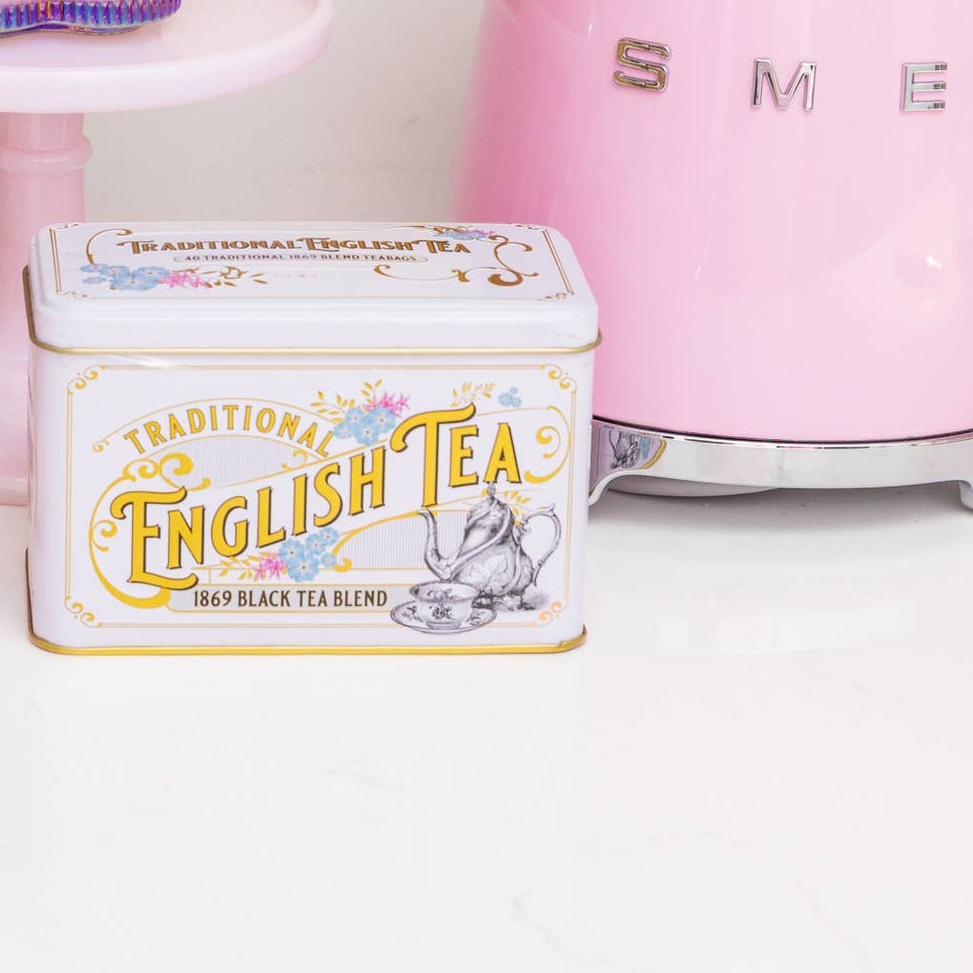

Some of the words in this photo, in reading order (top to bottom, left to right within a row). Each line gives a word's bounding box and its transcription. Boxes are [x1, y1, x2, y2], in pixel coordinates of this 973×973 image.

[116, 240, 302, 255] TRADITIONAL
[297, 237, 414, 253] ENGLISH
[412, 239, 472, 254] TEA
[185, 254, 201, 262] 40
[204, 253, 284, 261] TRADITIONAL
[289, 253, 317, 261] 1869
[321, 253, 360, 261] BLEND
[364, 253, 417, 262] TEABAGS
[123, 404, 335, 458] TRADITIONAL
[109, 444, 388, 590] ENGLISH
[390, 402, 523, 508] TEA
[193, 589, 232, 607] 1869
[238, 589, 292, 607] BLACK
[297, 589, 328, 607] TEA
[333, 589, 388, 607] BLEND
